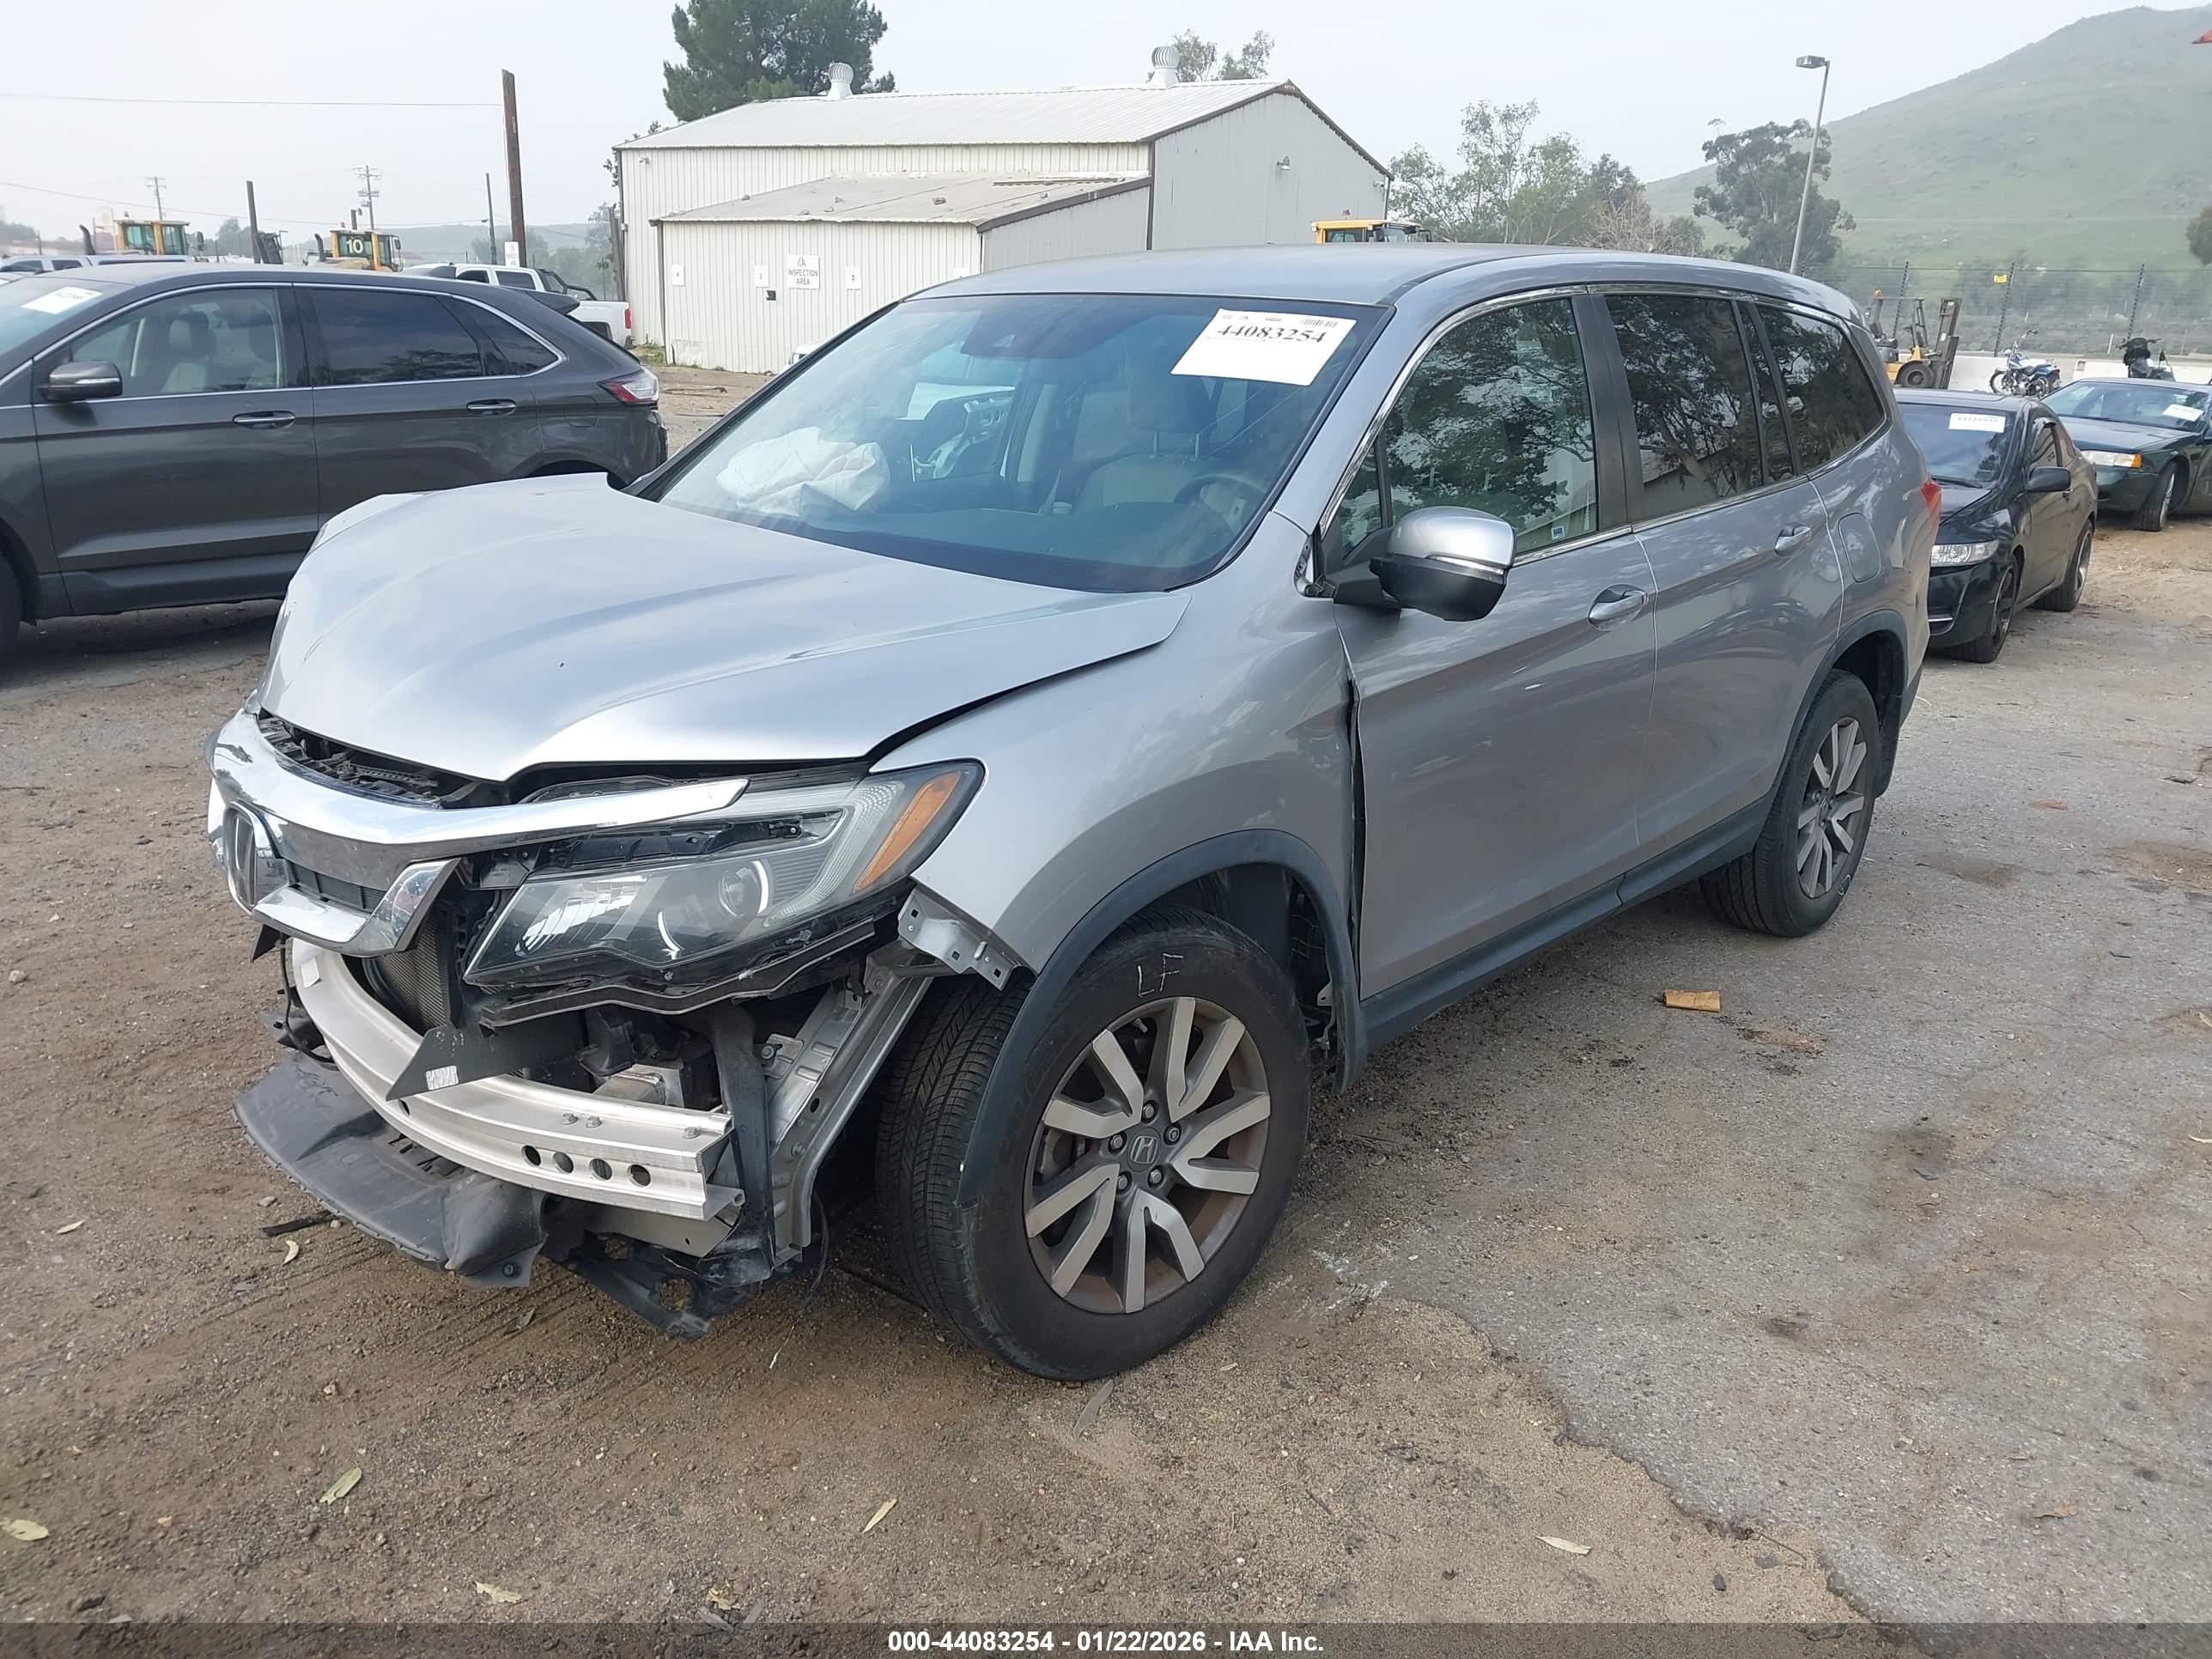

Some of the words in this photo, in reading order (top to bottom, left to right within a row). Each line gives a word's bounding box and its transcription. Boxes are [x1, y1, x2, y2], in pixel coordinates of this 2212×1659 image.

[346, 239, 363, 253] 10
[787, 268, 818, 277] INSPECTION
[1217, 324, 1328, 343] 44083254
[1137, 952, 1184, 998] LF
